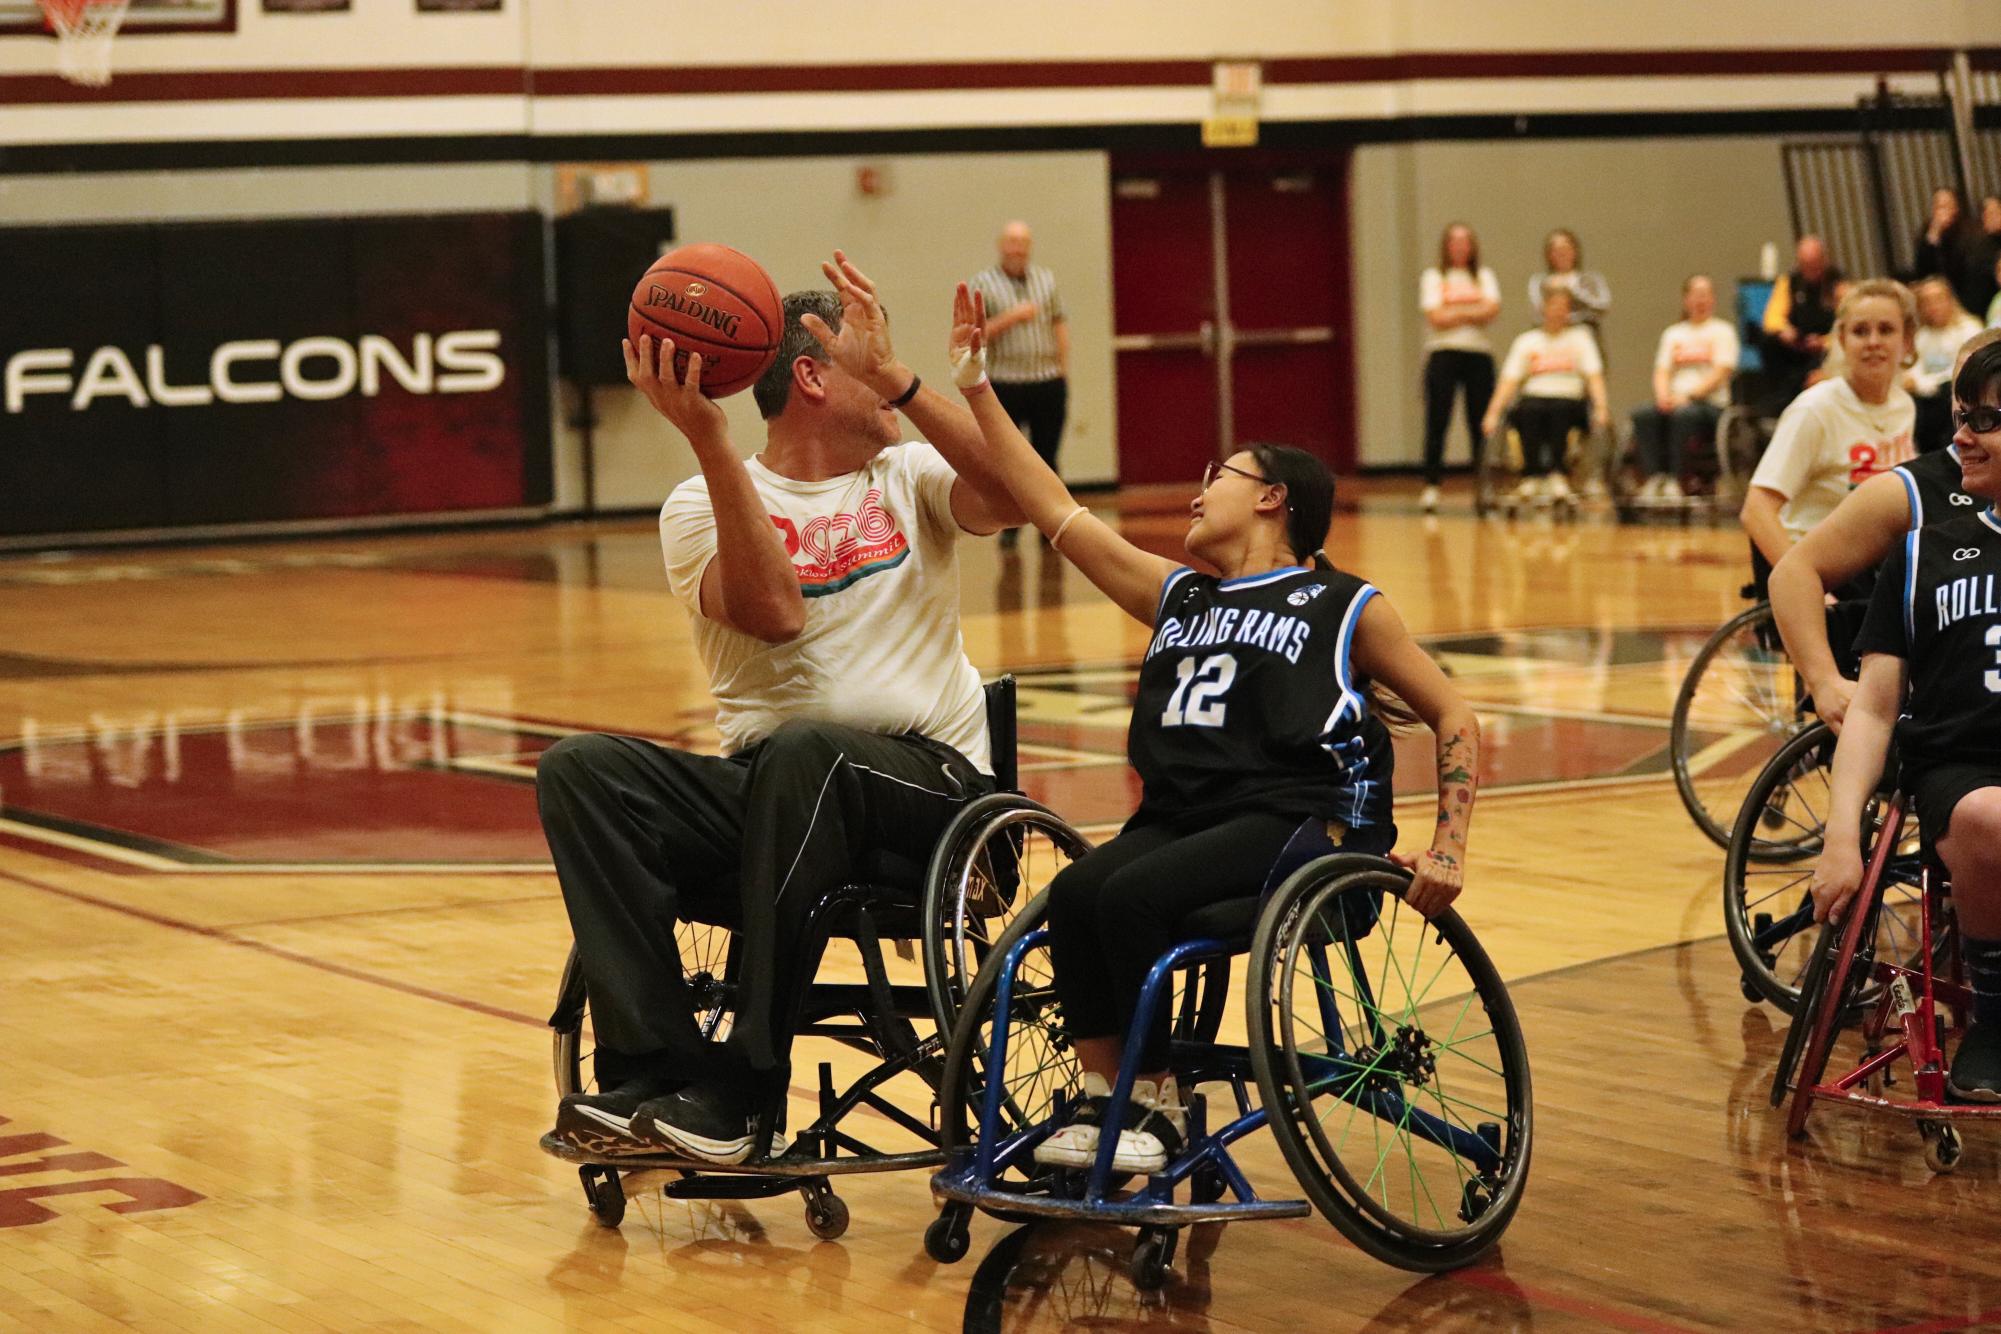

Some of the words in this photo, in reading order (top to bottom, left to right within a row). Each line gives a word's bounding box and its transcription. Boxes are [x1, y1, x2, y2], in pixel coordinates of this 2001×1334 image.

[644, 284, 742, 339] SPALDING
[5, 330, 506, 414] FALCONS
[1935, 573, 1999, 632] ROLL
[1234, 608, 1311, 665] RAMS
[1160, 652, 1238, 727] 12
